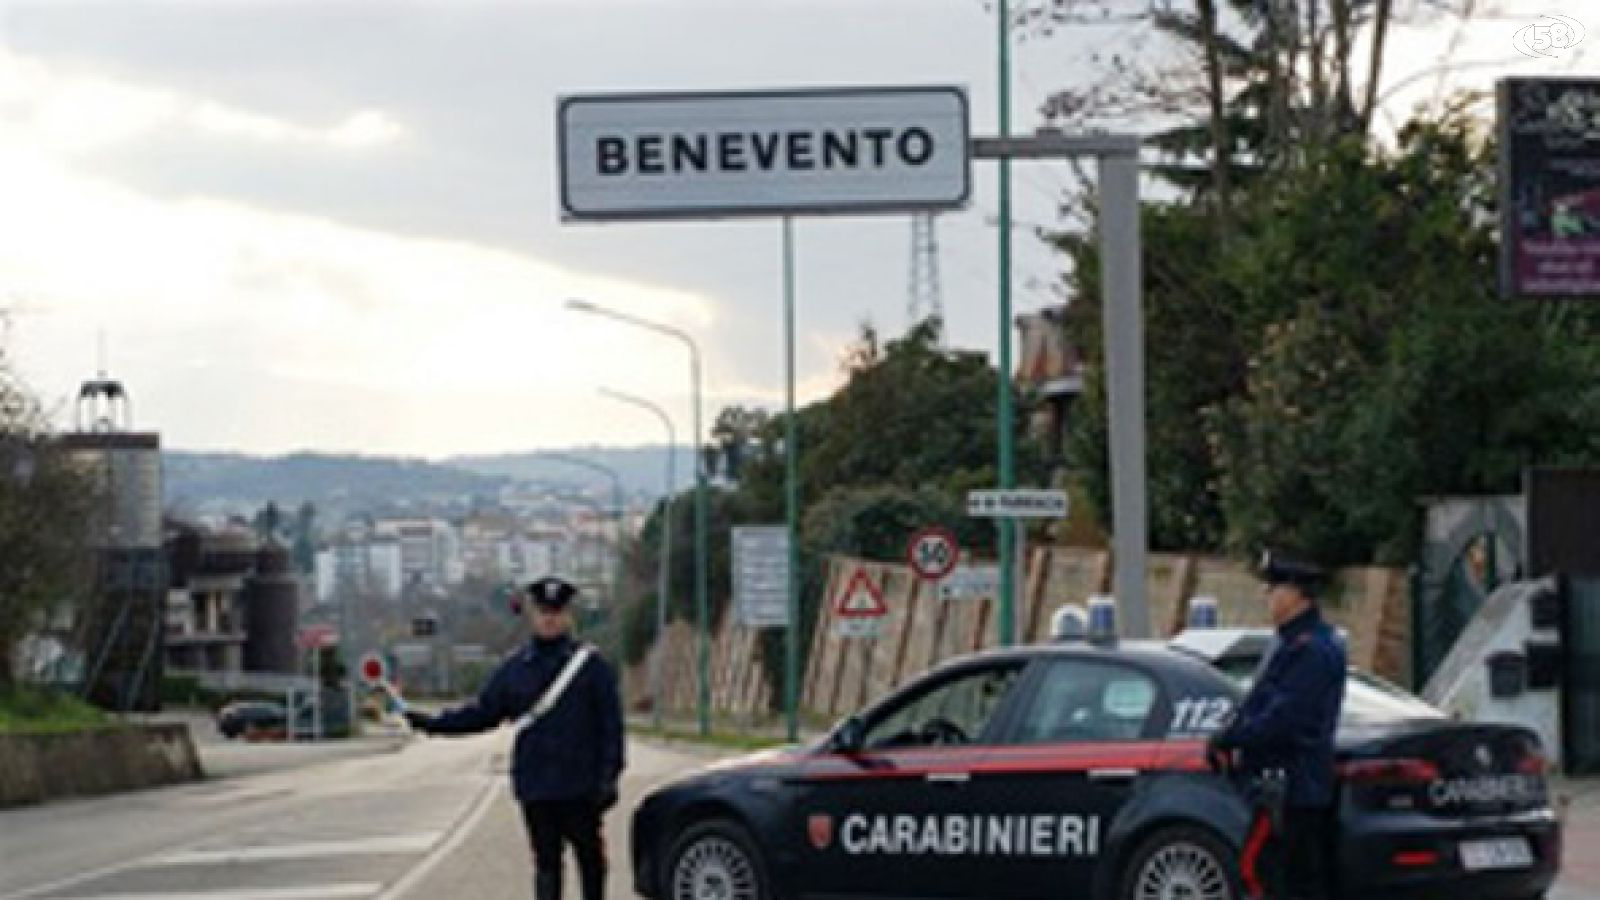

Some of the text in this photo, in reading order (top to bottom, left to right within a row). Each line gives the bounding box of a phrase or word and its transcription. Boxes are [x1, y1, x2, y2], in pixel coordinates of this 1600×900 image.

[596, 126, 934, 176] BENEVENTO
[1171, 696, 1234, 729] 112
[841, 814, 1100, 855] CARABINIERI
